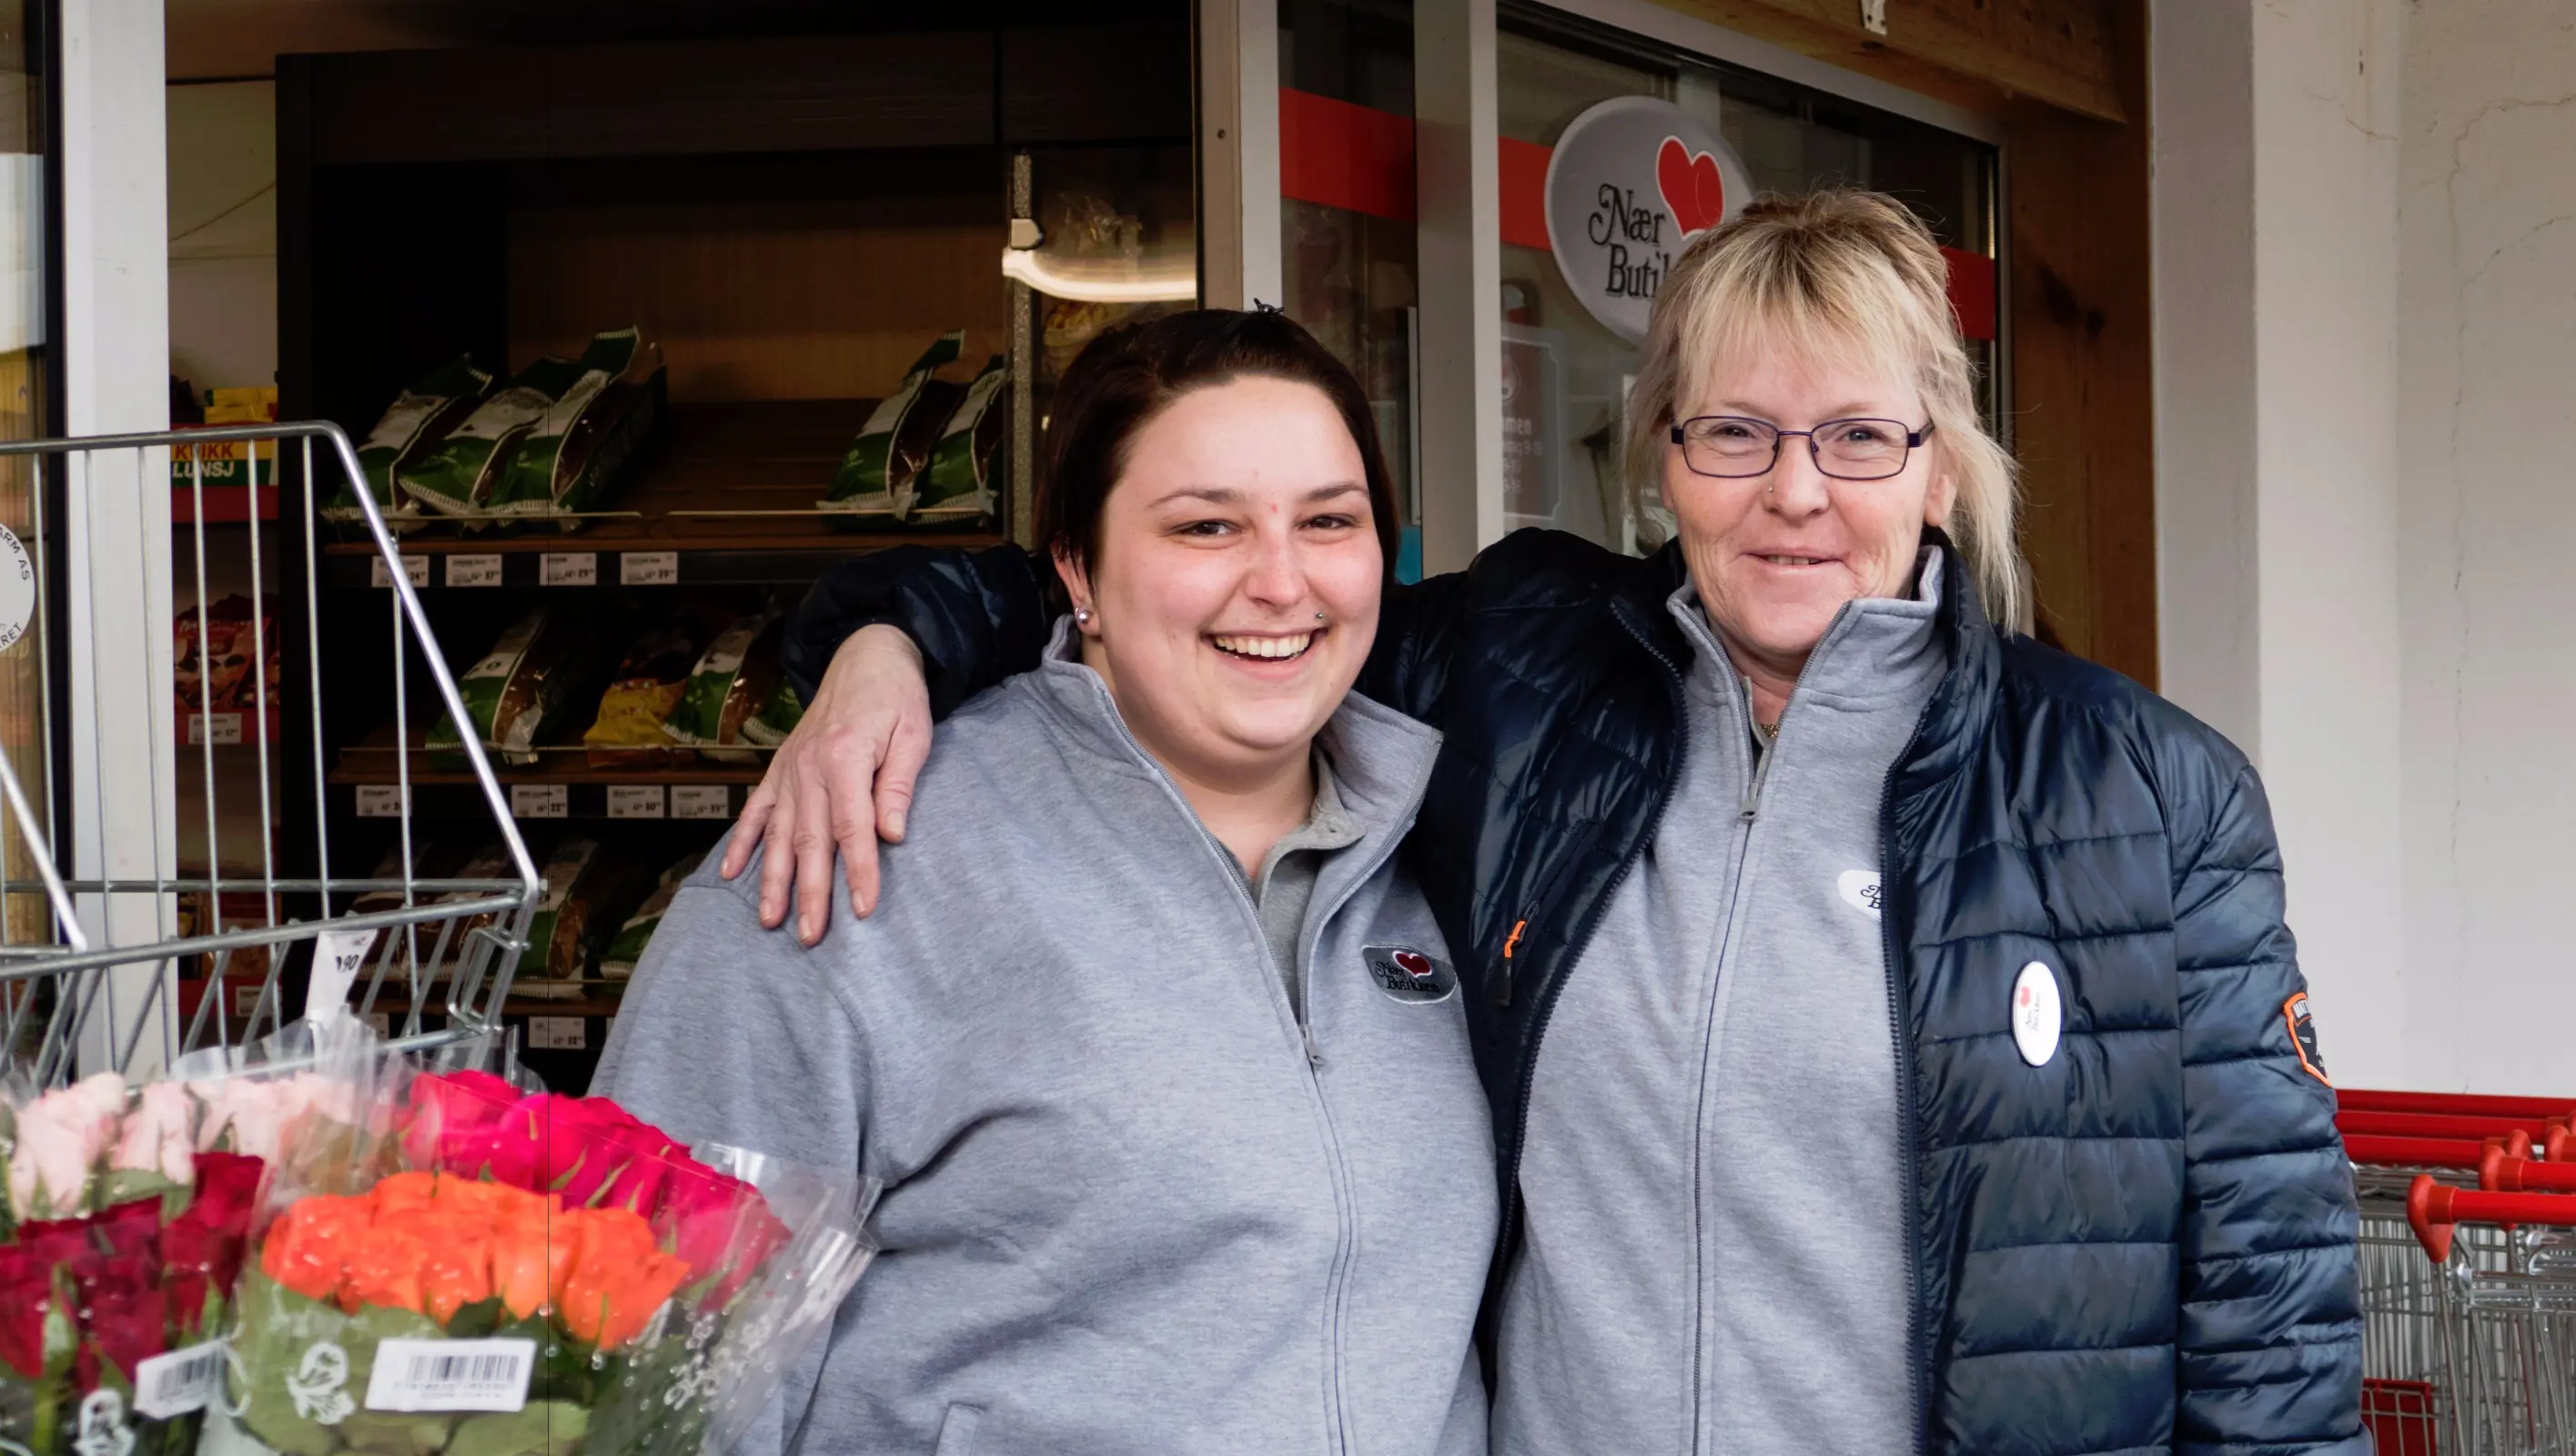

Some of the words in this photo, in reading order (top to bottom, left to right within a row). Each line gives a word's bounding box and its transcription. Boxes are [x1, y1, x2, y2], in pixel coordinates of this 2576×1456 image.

[1588, 183, 1666, 246] Nær
[175, 442, 234, 460] KIKK
[18, 559, 30, 581] AS
[0, 622, 22, 649] RET
